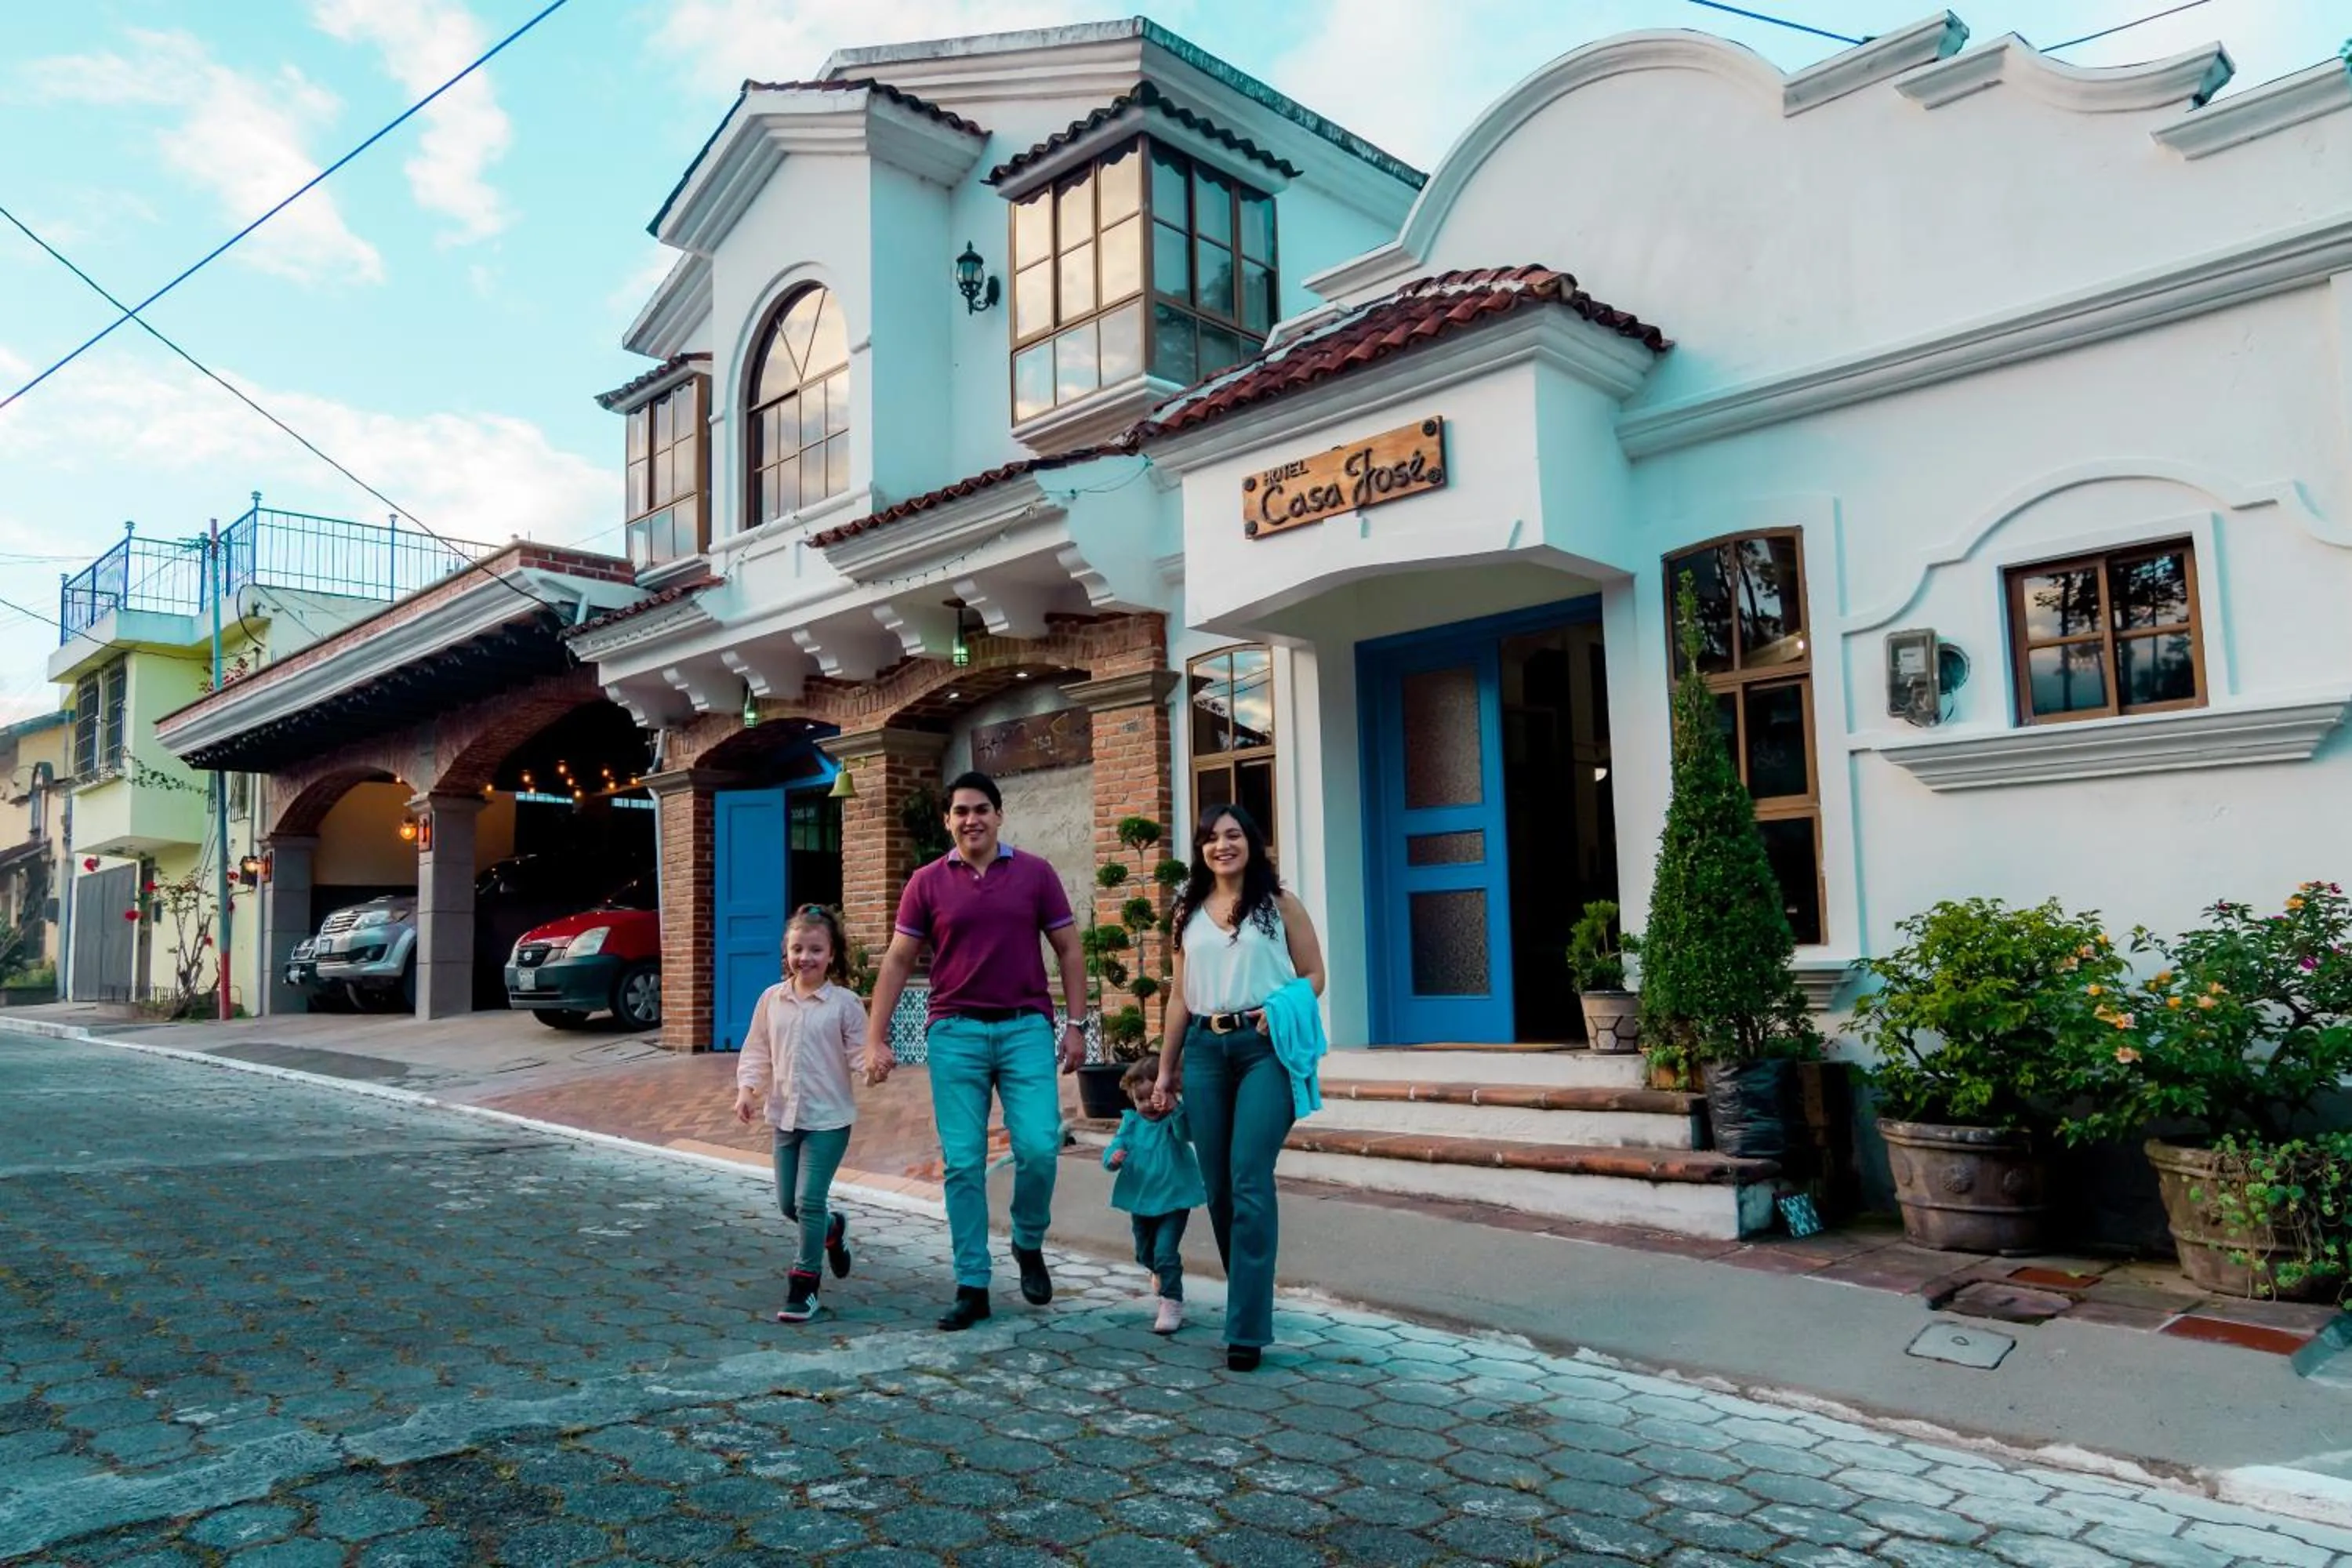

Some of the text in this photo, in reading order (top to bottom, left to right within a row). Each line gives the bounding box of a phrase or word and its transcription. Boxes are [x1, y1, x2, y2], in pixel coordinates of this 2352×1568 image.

[1261, 448, 1426, 525] Casa José
[1264, 460, 1309, 486] HOTEL
